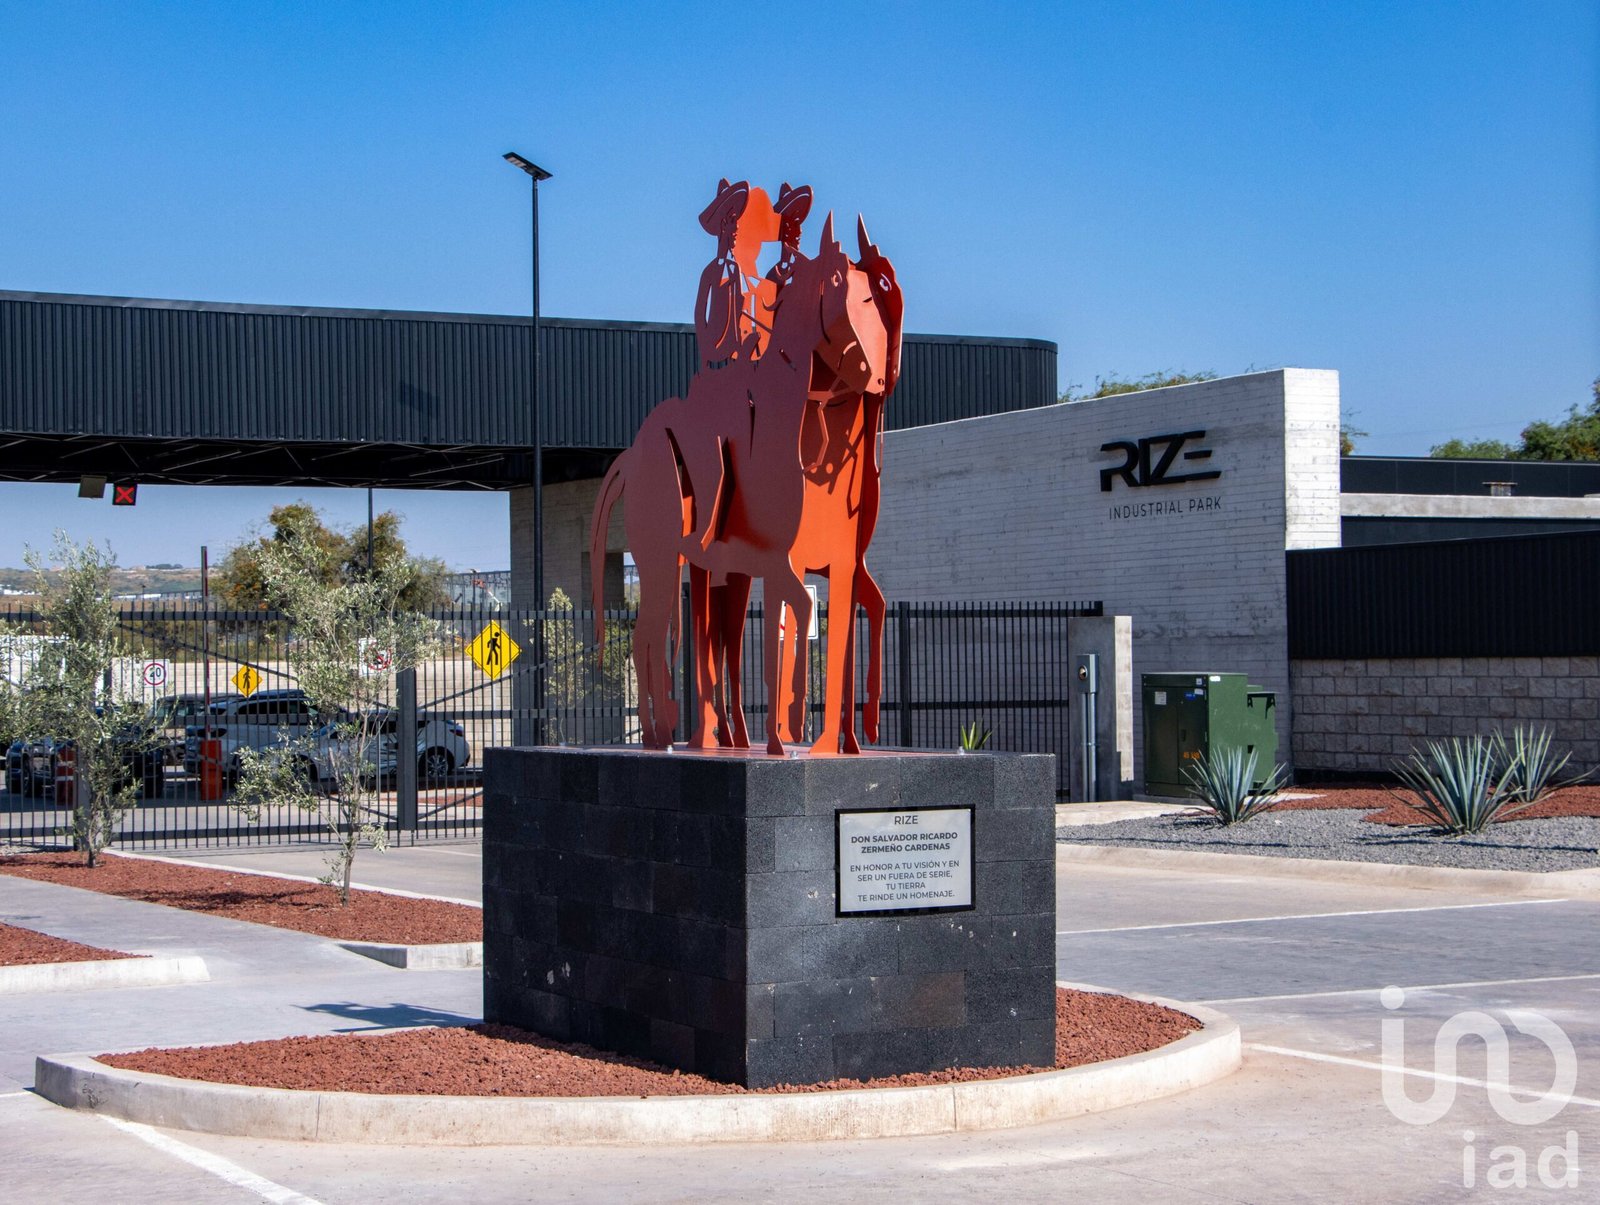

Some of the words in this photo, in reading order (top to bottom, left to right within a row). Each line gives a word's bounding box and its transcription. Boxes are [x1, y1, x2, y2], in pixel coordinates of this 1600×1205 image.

[1100, 430, 1222, 492] RIZE
[1109, 500, 1183, 520] INDUSTRIAL
[1189, 496, 1222, 513] PARK
[894, 815, 919, 825] RIZE
[851, 836, 871, 844] DON
[873, 833, 918, 843] SALVADOR
[920, 832, 958, 841] RICARDO
[861, 843, 902, 854] ZERMEÑO
[904, 842, 951, 852] CARDENAS
[863, 863, 893, 872] HONOR
[902, 862, 912, 870] TU
[914, 860, 940, 869] VISIÓN
[941, 860, 948, 868] Y
[857, 874, 872, 882] SER
[874, 873, 887, 881] UN
[888, 872, 915, 880] FUERA
[916, 871, 927, 879] DE
[929, 870, 953, 879] SERIE,
[886, 883, 896, 891] TU
[898, 882, 926, 890] TIERRA
[857, 894, 867, 902] TE
[869, 893, 894, 901] RINDE
[896, 892, 908, 900] UN
[909, 890, 955, 900] HOMENAJE.
